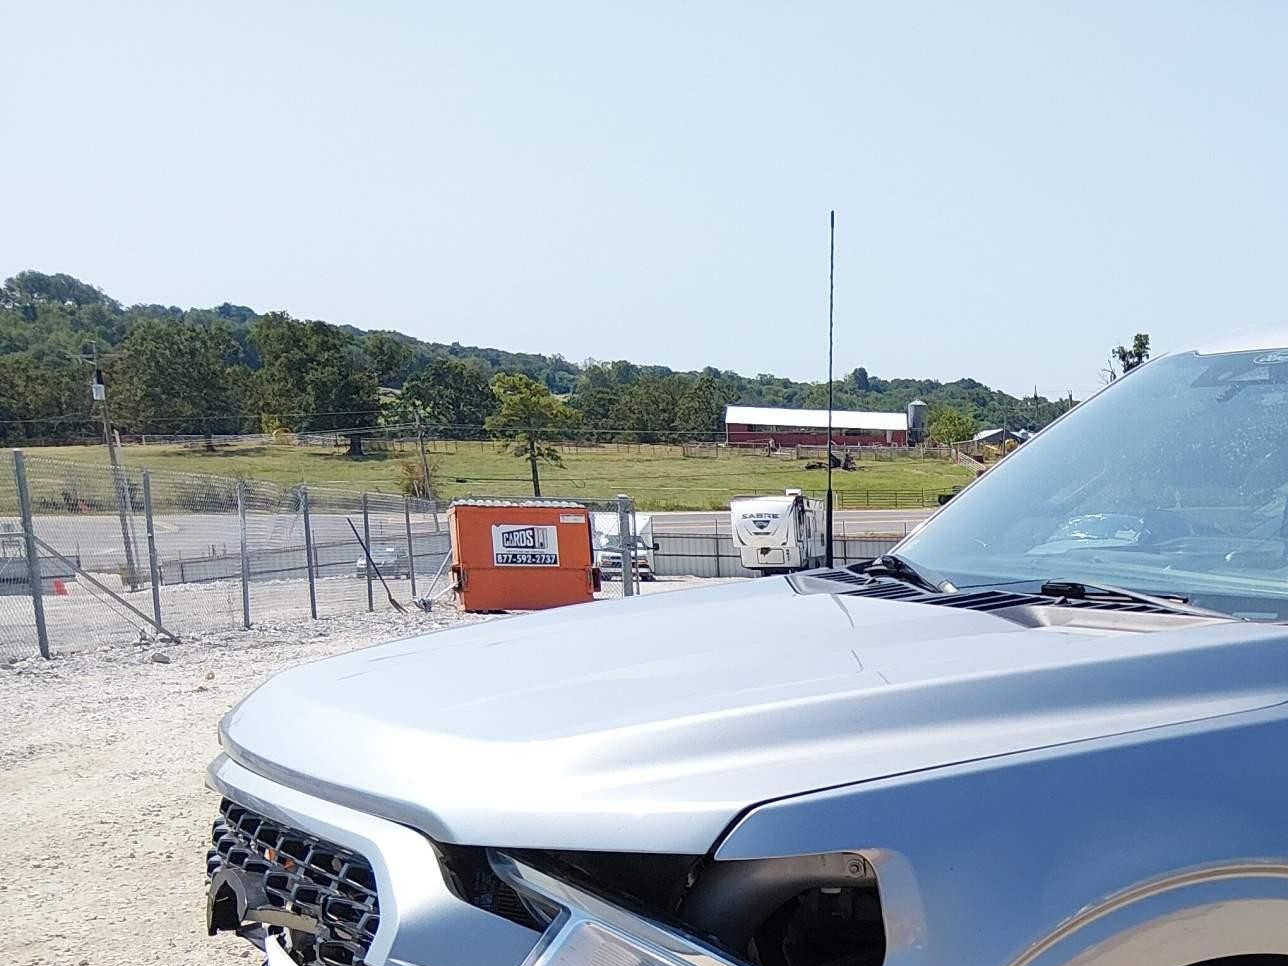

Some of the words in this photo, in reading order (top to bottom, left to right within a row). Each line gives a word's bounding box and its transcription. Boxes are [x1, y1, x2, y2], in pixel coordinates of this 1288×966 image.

[741, 512, 781, 520] SABRE
[503, 528, 534, 547] CARDS
[497, 553, 556, 564] 877-592-2737
